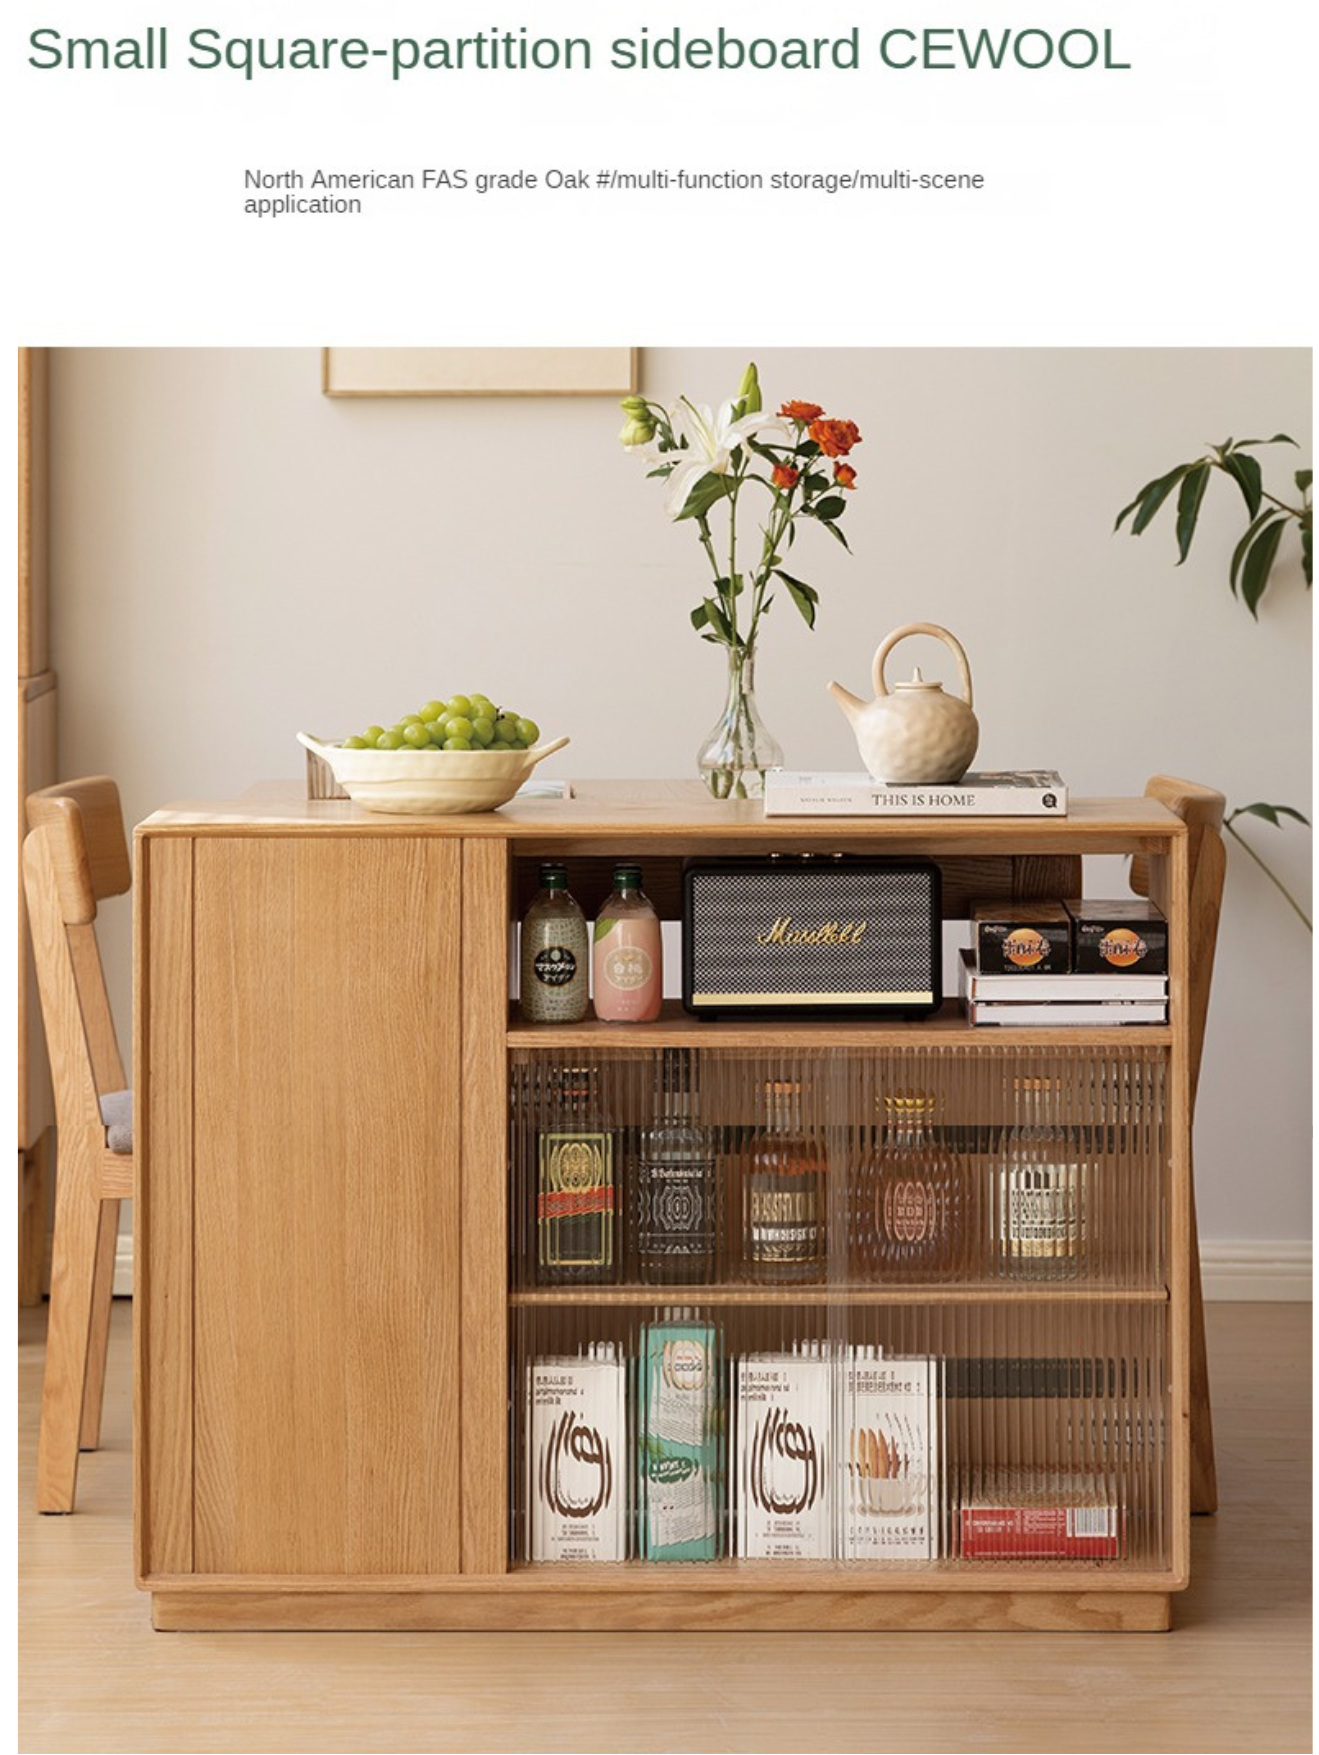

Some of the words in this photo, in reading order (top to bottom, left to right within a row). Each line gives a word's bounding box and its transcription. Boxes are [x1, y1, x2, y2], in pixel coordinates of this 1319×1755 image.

[872, 793, 908, 807] THIS
[912, 793, 925, 807] IS
[929, 793, 976, 807] HOME
